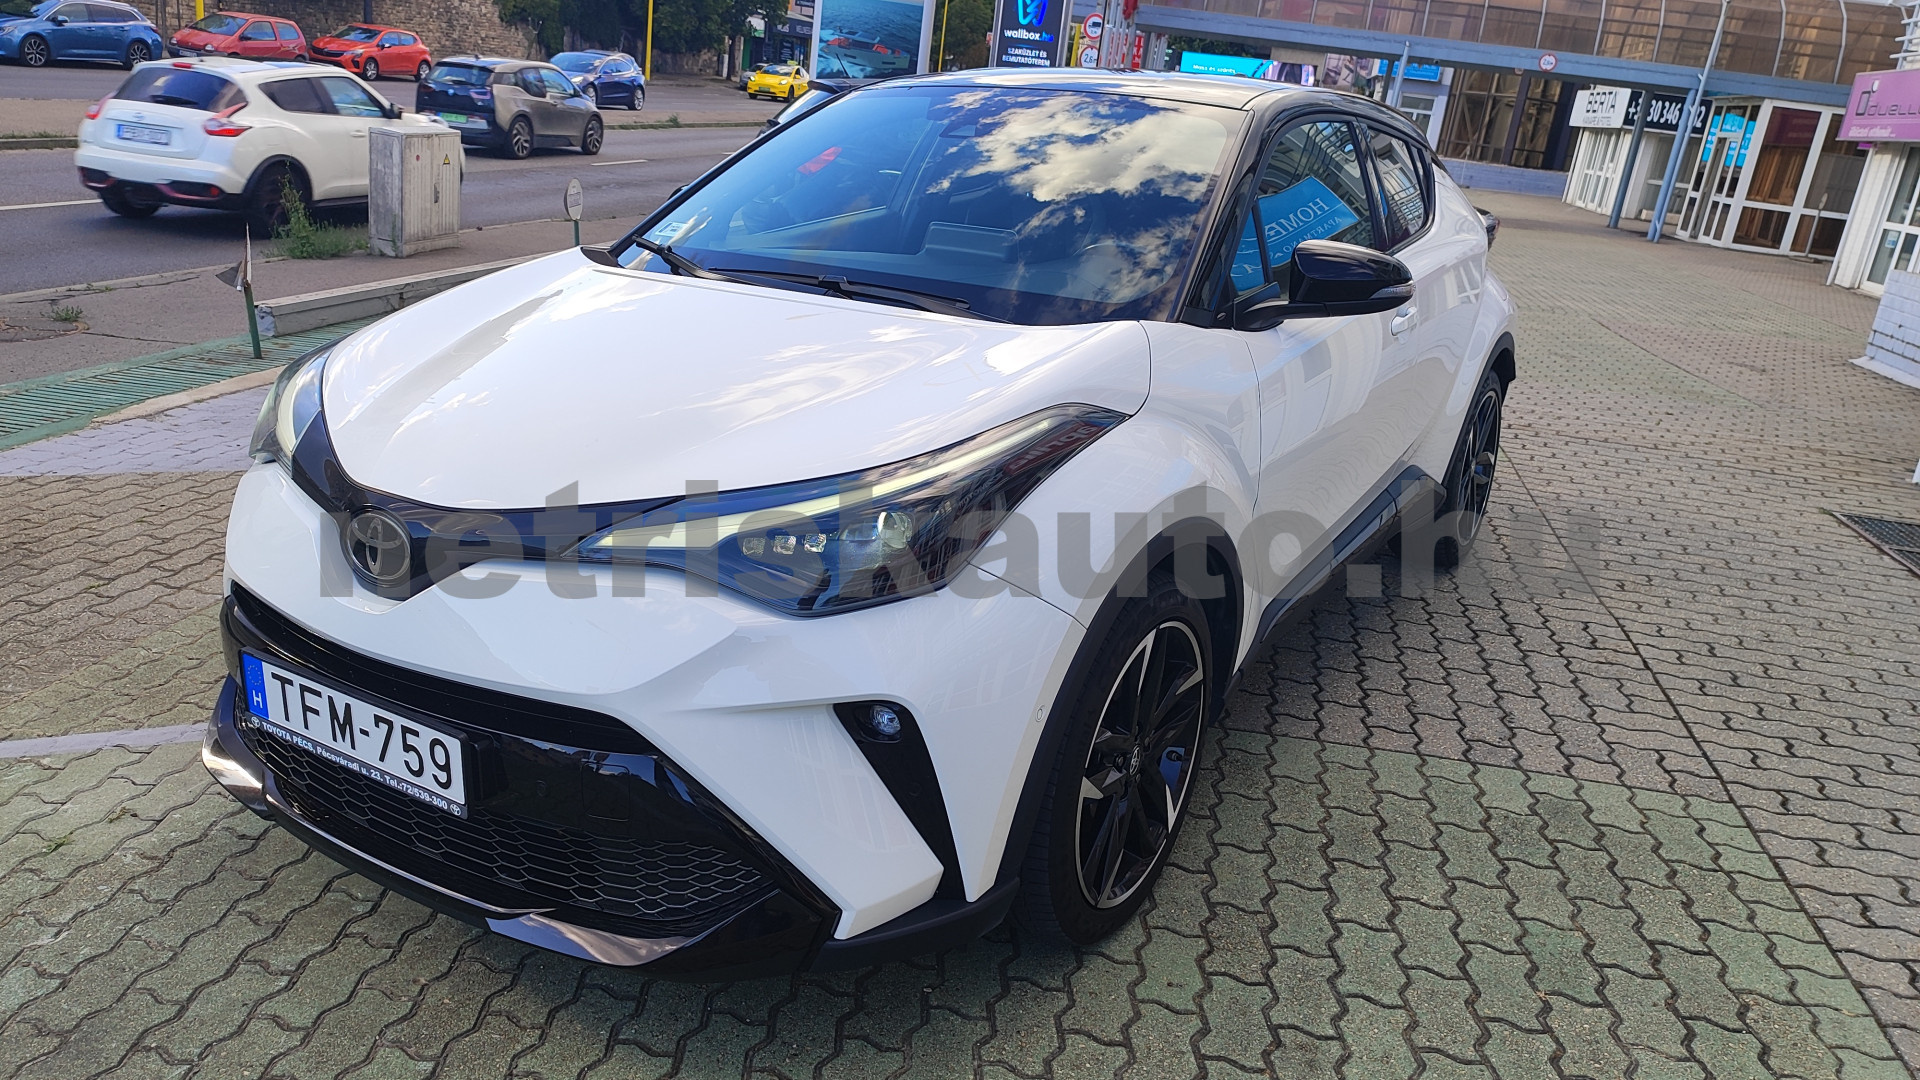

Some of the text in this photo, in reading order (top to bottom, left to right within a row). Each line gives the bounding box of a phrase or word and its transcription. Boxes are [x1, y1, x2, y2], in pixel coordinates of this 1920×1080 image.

[1003, 28, 1054, 42] wallbox.hu
[1585, 91, 1617, 113] BERTA
[1647, 99, 1662, 122] 30
[1660, 101, 1682, 125] 346
[252, 689, 263, 708] H
[271, 671, 452, 790] TFM-759
[262, 721, 292, 741] TOYOTA
[293, 735, 316, 753] PÉCS,
[316, 746, 360, 771] Pécsváradi
[360, 766, 369, 775] u.
[370, 769, 383, 781] 23.
